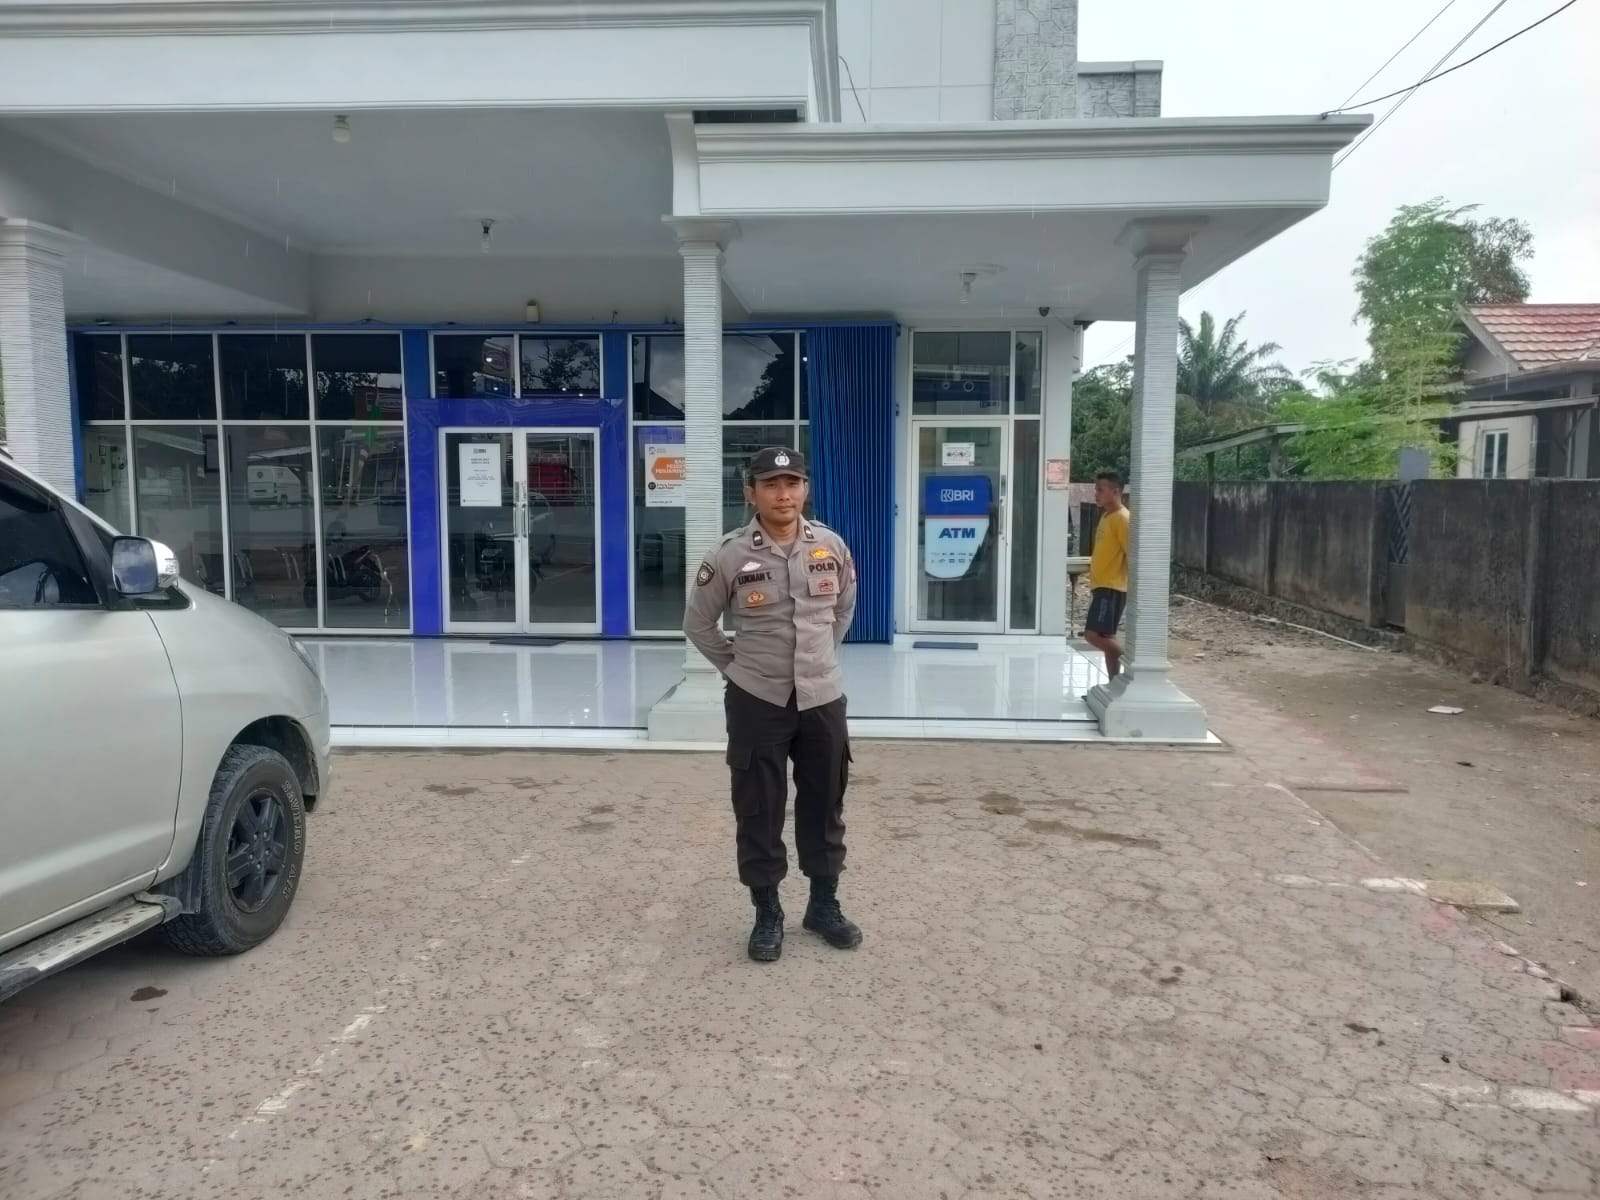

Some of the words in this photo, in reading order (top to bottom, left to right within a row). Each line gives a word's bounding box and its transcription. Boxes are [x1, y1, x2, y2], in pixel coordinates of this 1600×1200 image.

[953, 489, 974, 501] BRI
[939, 527, 976, 539] ATM
[808, 562, 835, 573] POLRI
